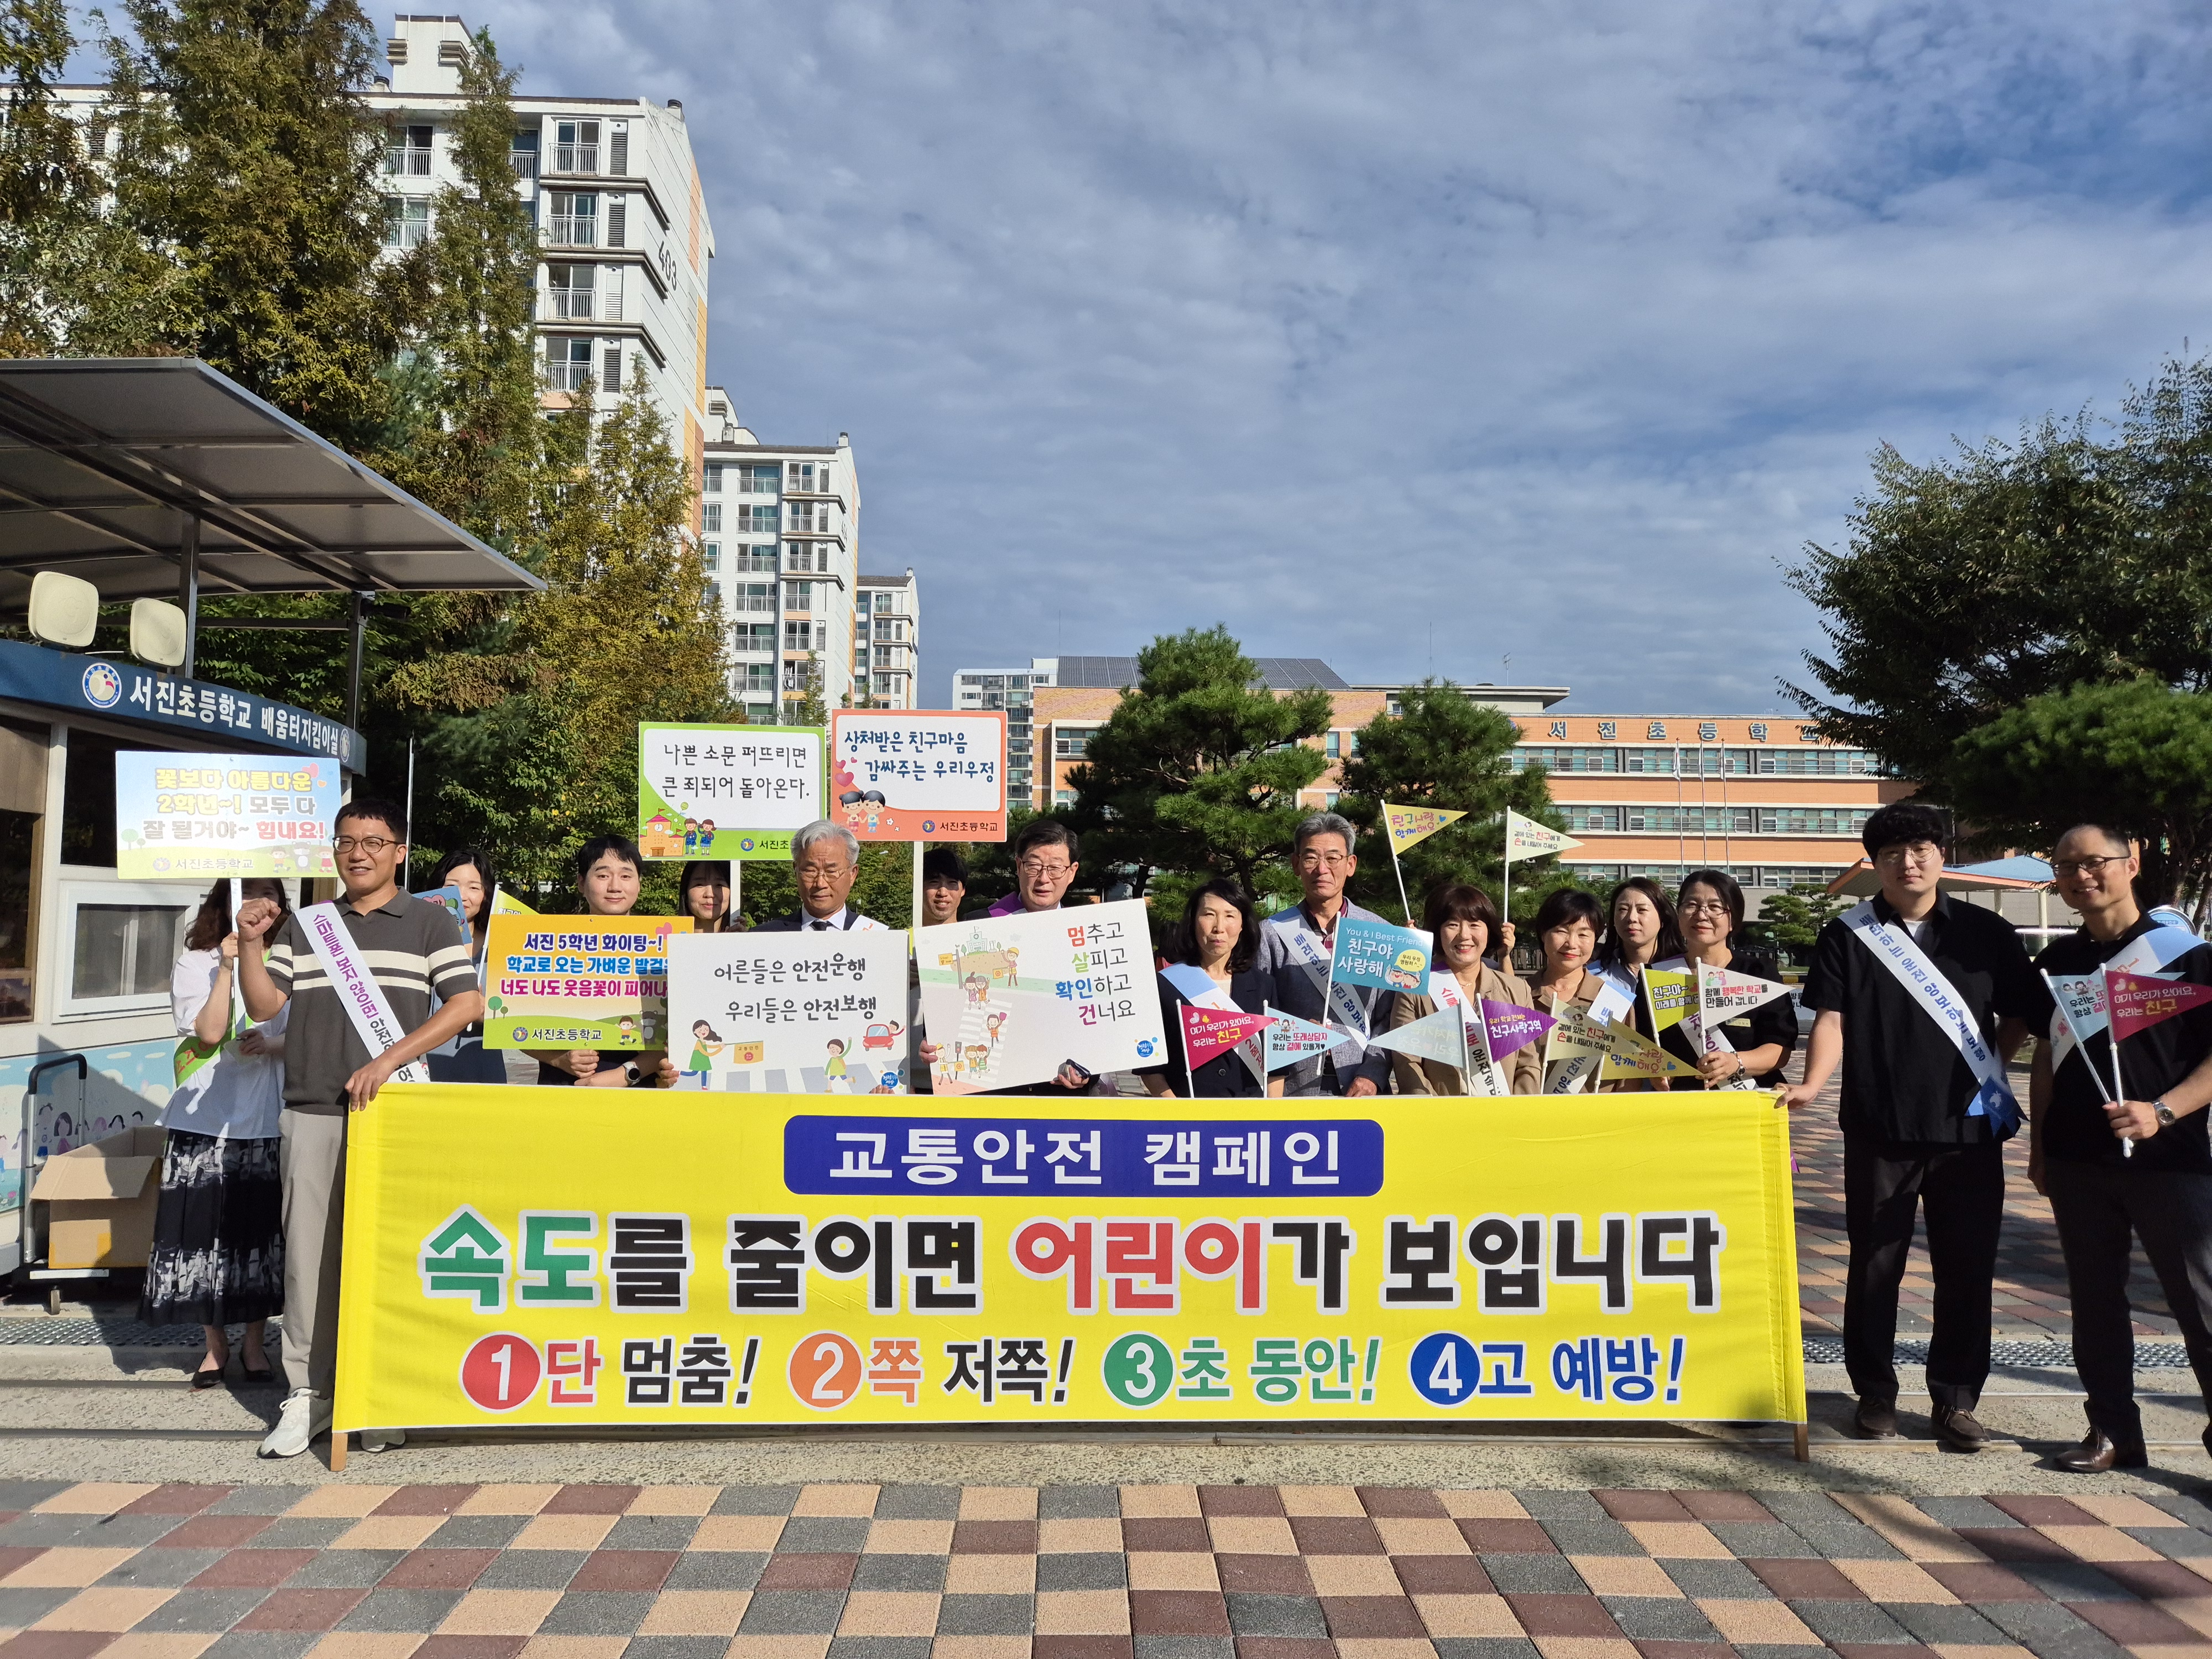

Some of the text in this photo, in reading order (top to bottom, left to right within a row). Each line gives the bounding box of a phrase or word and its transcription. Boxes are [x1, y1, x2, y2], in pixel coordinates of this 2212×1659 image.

[658, 239, 677, 291] 403
[129, 676, 252, 729] 서진초등학교
[261, 706, 339, 756] 배움터지킴이실
[844, 731, 969, 755] 상처받은 친구마음
[664, 744, 807, 769] 나쁜 소문 퍼뜨리면
[155, 768, 312, 792] 꽃보다 아름다운
[868, 760, 994, 784] 감싸주는 우리우정
[662, 775, 810, 801] 큰 죄되어 돌아온다.
[249, 796, 290, 815] 모두
[296, 797, 316, 816] 다
[940, 820, 998, 832] 서진초등학교
[1390, 812, 1434, 826] 친구사랑
[143, 820, 165, 840] 잘
[256, 821, 325, 841] 힘내요!
[1536, 831, 1561, 842] 친구에게
[175, 858, 254, 870] 서진초등학교
[524, 933, 662, 952] 서진 5학년 화이팅~!
[1067, 922, 1124, 947] 멈추고
[1346, 927, 1361, 937] You
[1375, 932, 1395, 942] Best
[1397, 936, 1424, 947] Friend
[1347, 938, 1394, 960] 친구야
[313, 914, 345, 958] 스마트폰
[336, 956, 359, 983] 보지
[349, 981, 379, 1019] 않으면
[507, 956, 550, 974] 학교로
[555, 957, 583, 974] 오는
[587, 957, 631, 974] 가벼운
[714, 952, 867, 983] 어른들은 안전운행
[1072, 948, 1128, 973] 살피고
[1337, 956, 1384, 978] 사랑해
[1901, 957, 1928, 983] 운전
[500, 979, 529, 996] 너도
[533, 980, 560, 996] 나도
[564, 979, 620, 997] 웃음꽃이
[1055, 974, 1133, 1001] 확인하고
[1705, 984, 1768, 997] 함께 행복한 학교를
[2114, 994, 2132, 1004] 여기
[2133, 990, 2160, 1000] 우리가
[726, 994, 877, 1022] 우리들은 안전보행
[1677, 995, 1692, 1006] 함께
[1705, 996, 1734, 1009] 만들어
[1735, 995, 1758, 1006] 갑니다
[2069, 996, 2095, 1008] 우리는
[2117, 999, 2177, 1018] 우리는 친구
[1078, 1000, 1136, 1026] 건너요
[1343, 999, 1371, 1042] 양보하
[2073, 1006, 2091, 1018] 항상
[531, 1027, 602, 1041] 서진초등학교
[1190, 1016, 1254, 1035] 여기 우리가 있어요,
[1490, 1019, 1543, 1039] 친구사랑구역
[1558, 1023, 1616, 1044] 곁에 있는 친구에게
[1193, 1027, 1242, 1047] 우리는 친구
[1272, 1042, 1285, 1051] 항상
[1287, 1042, 1301, 1051] 곁에
[1293, 1032, 1327, 1041] 또래상담자
[1557, 1031, 1611, 1053] 손을 내밀어 주세요
[828, 1128, 1340, 1187] 교통안전 캠페인
[423, 1211, 1720, 1310] 속도를 줄이면 어린이가 보입니다
[622, 1336, 759, 1405] 멈춤!
[943, 1337, 1074, 1404] 저쪽!
[1249, 1337, 1381, 1402] 동안!
[1552, 1336, 1685, 1402] 예방!
